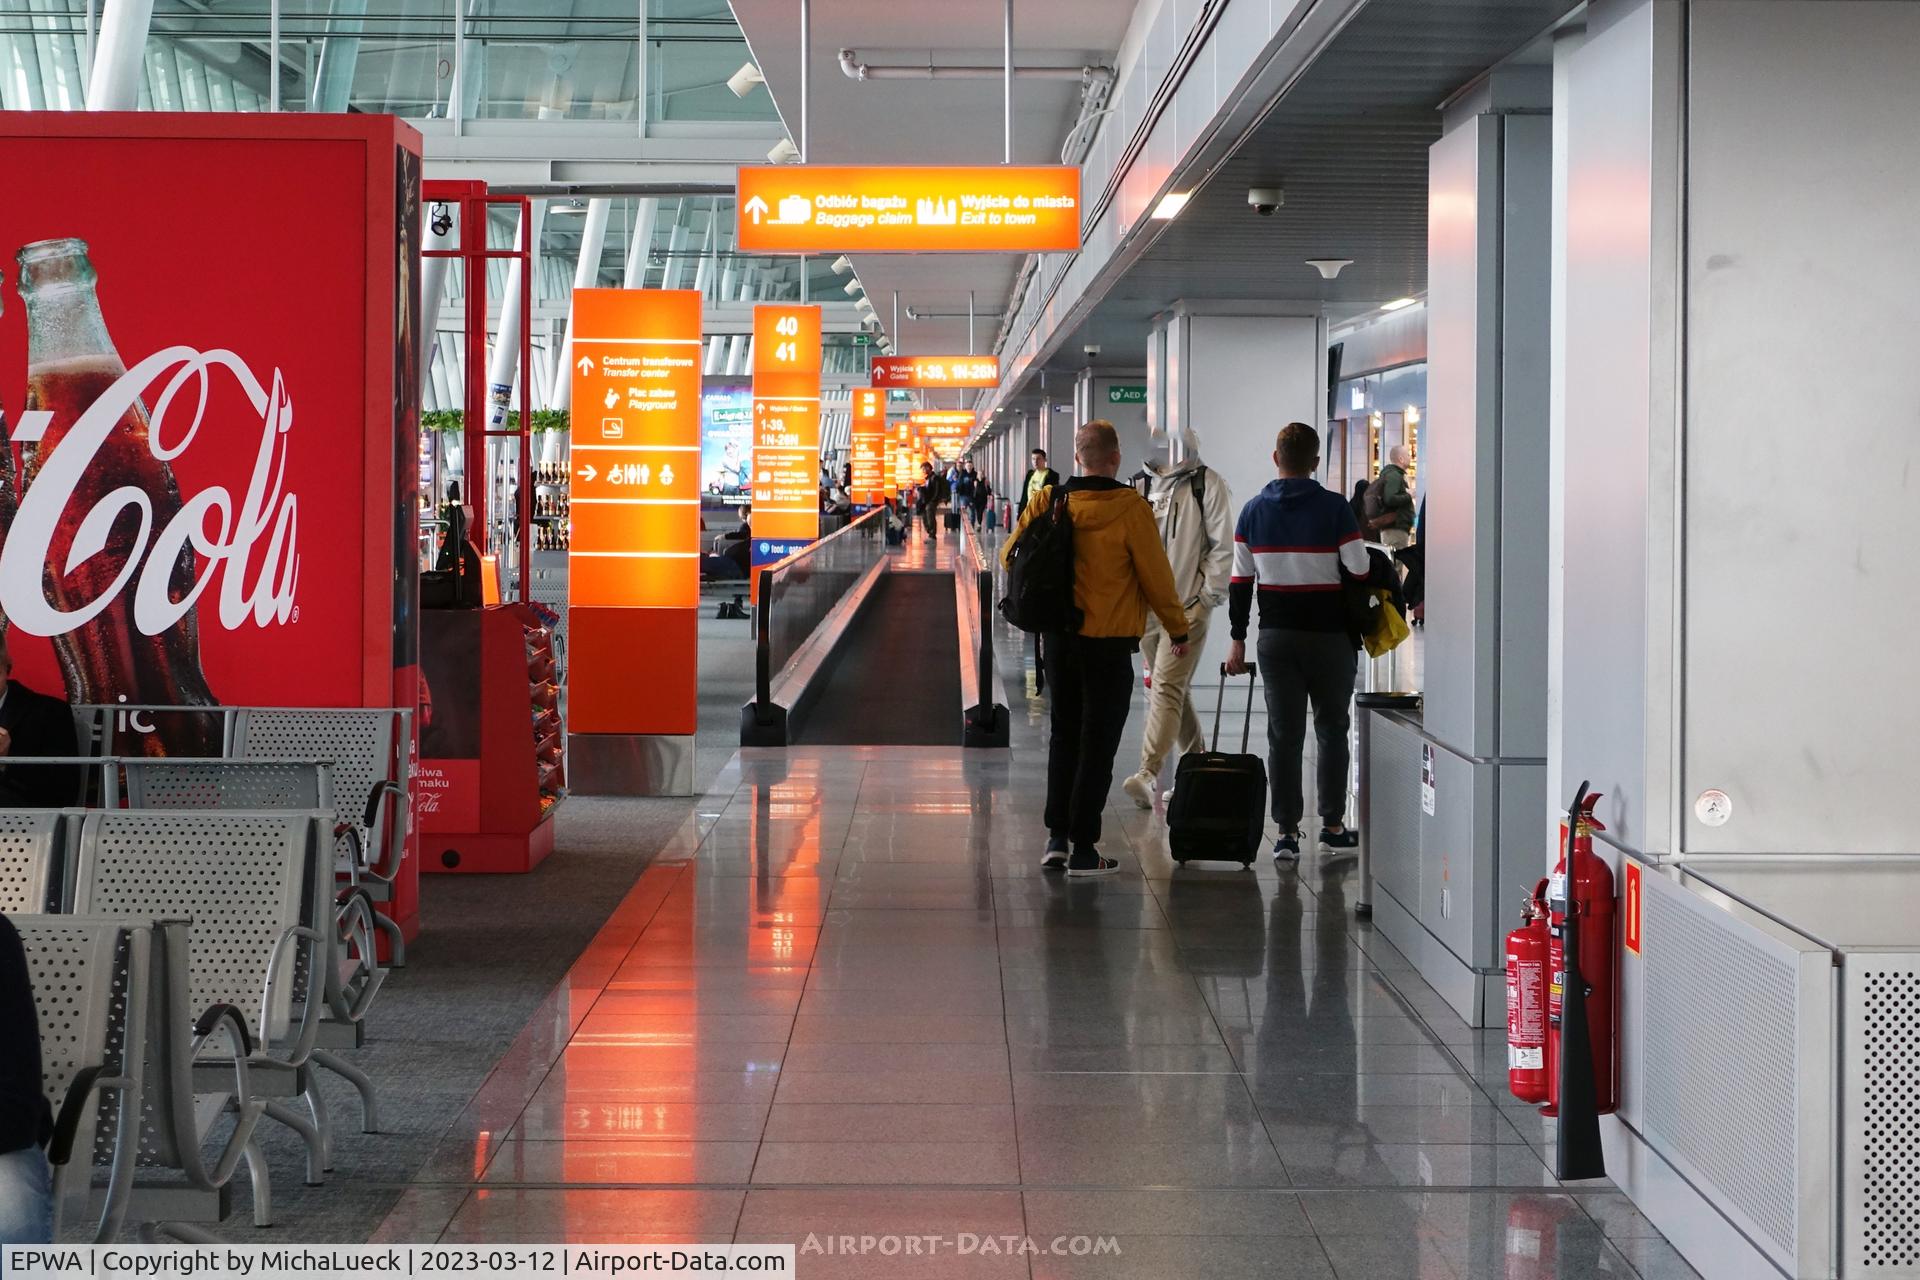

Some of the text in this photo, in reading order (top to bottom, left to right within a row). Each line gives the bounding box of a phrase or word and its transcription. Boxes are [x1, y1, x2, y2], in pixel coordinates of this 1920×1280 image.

[816, 195, 907, 211] Odbiór bagażu
[961, 195, 1075, 211] Wyjście do miasta
[816, 212, 913, 228] Baggage claim
[961, 212, 1036, 225] Exit to town
[776, 317, 799, 336] 40
[776, 341, 797, 362] 41
[602, 356, 694, 367] Centrum transferowe
[603, 367, 670, 378] Transfer center
[629, 388, 647, 398] Plac
[1123, 391, 1141, 399] AED
[629, 399, 677, 411] Playground
[761, 418, 787, 433] 1-39,
